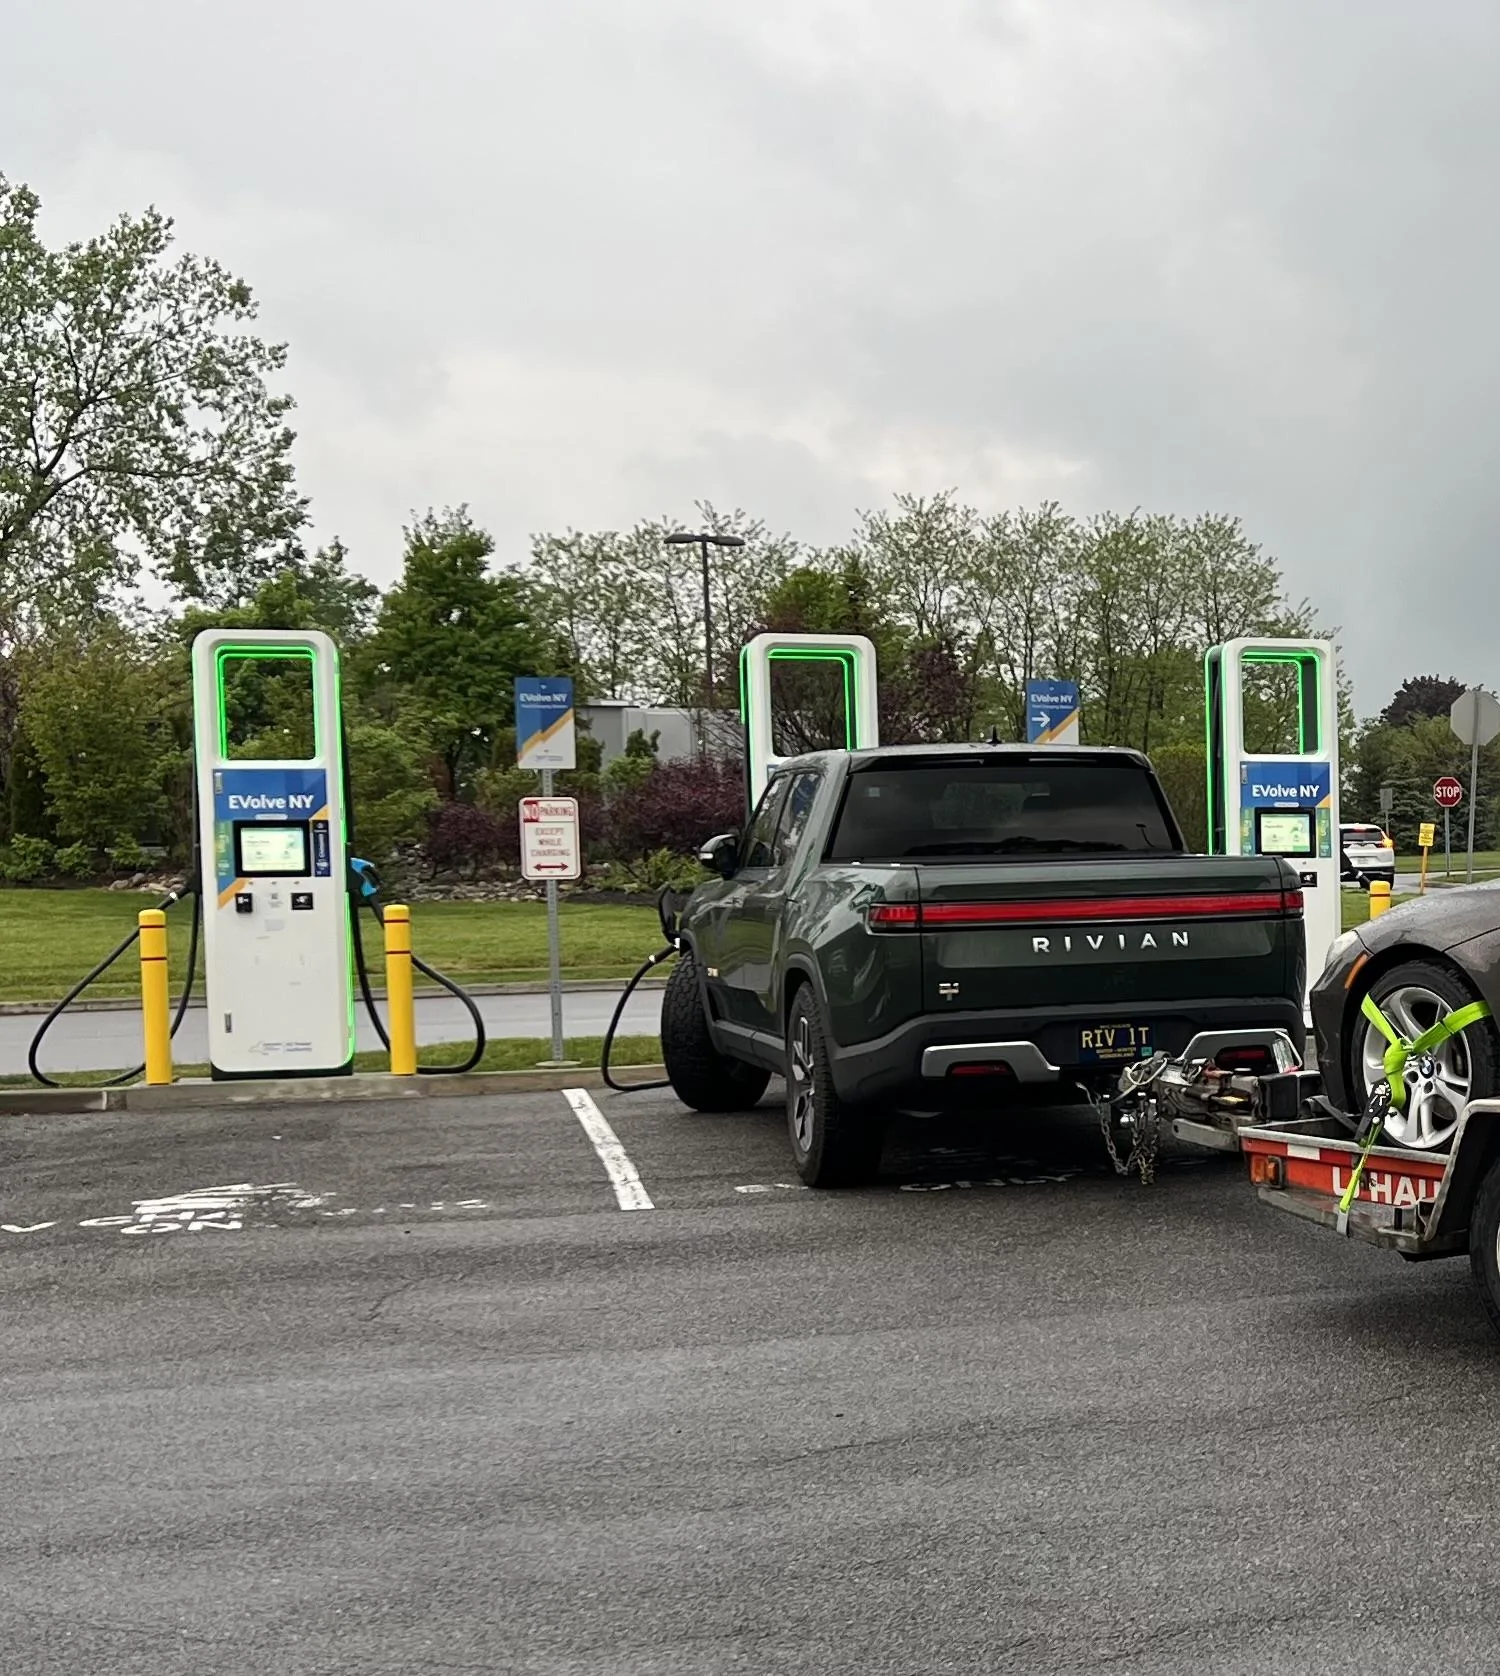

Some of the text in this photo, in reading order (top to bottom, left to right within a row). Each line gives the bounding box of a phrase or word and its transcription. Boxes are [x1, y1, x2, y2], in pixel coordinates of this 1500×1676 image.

[552, 693, 567, 702] NY
[1060, 694, 1073, 703] NY
[1252, 784, 1320, 798] EVolve NY
[1435, 786, 1460, 798] STOP
[228, 794, 314, 810] EVolve NY
[1032, 931, 1190, 953] RIVIAN
[1081, 1028, 1116, 1049] RIV
